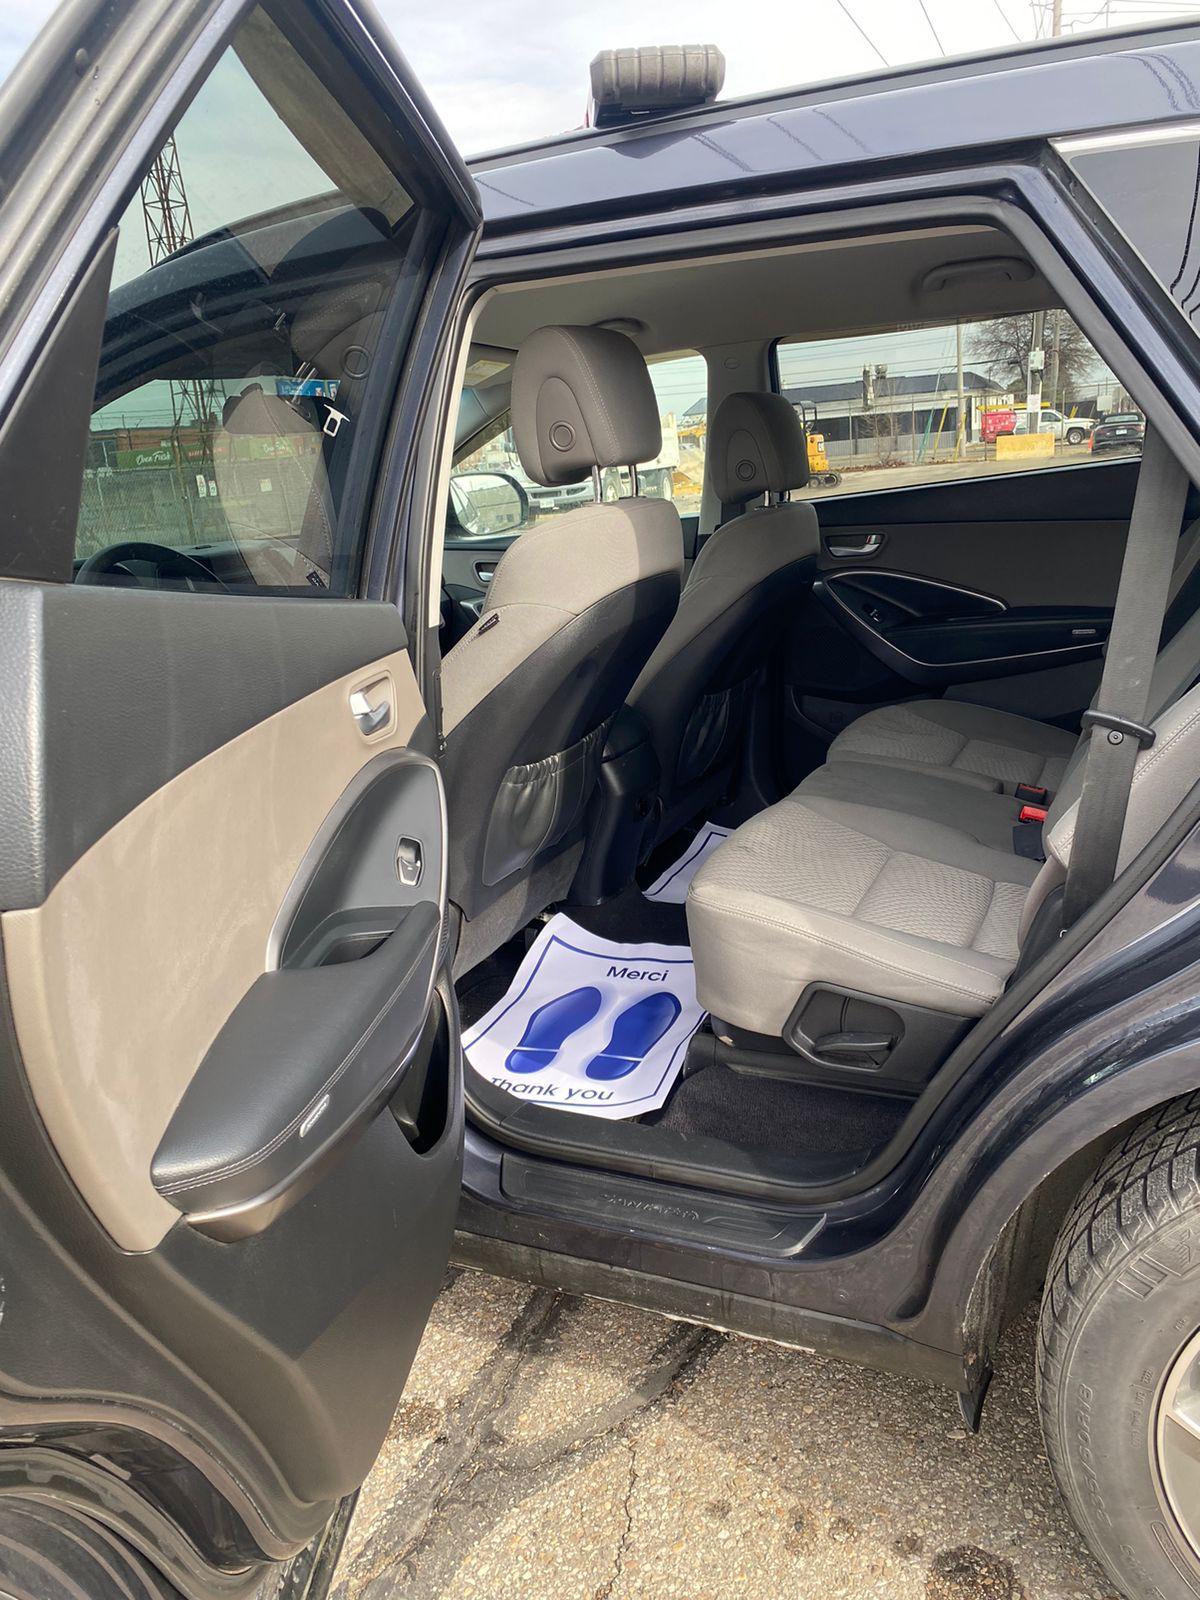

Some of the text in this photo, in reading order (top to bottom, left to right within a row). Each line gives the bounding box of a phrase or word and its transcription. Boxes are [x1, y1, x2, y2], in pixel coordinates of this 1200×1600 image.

[606, 966, 669, 982] Merci
[491, 1077, 615, 1101] Thank you
